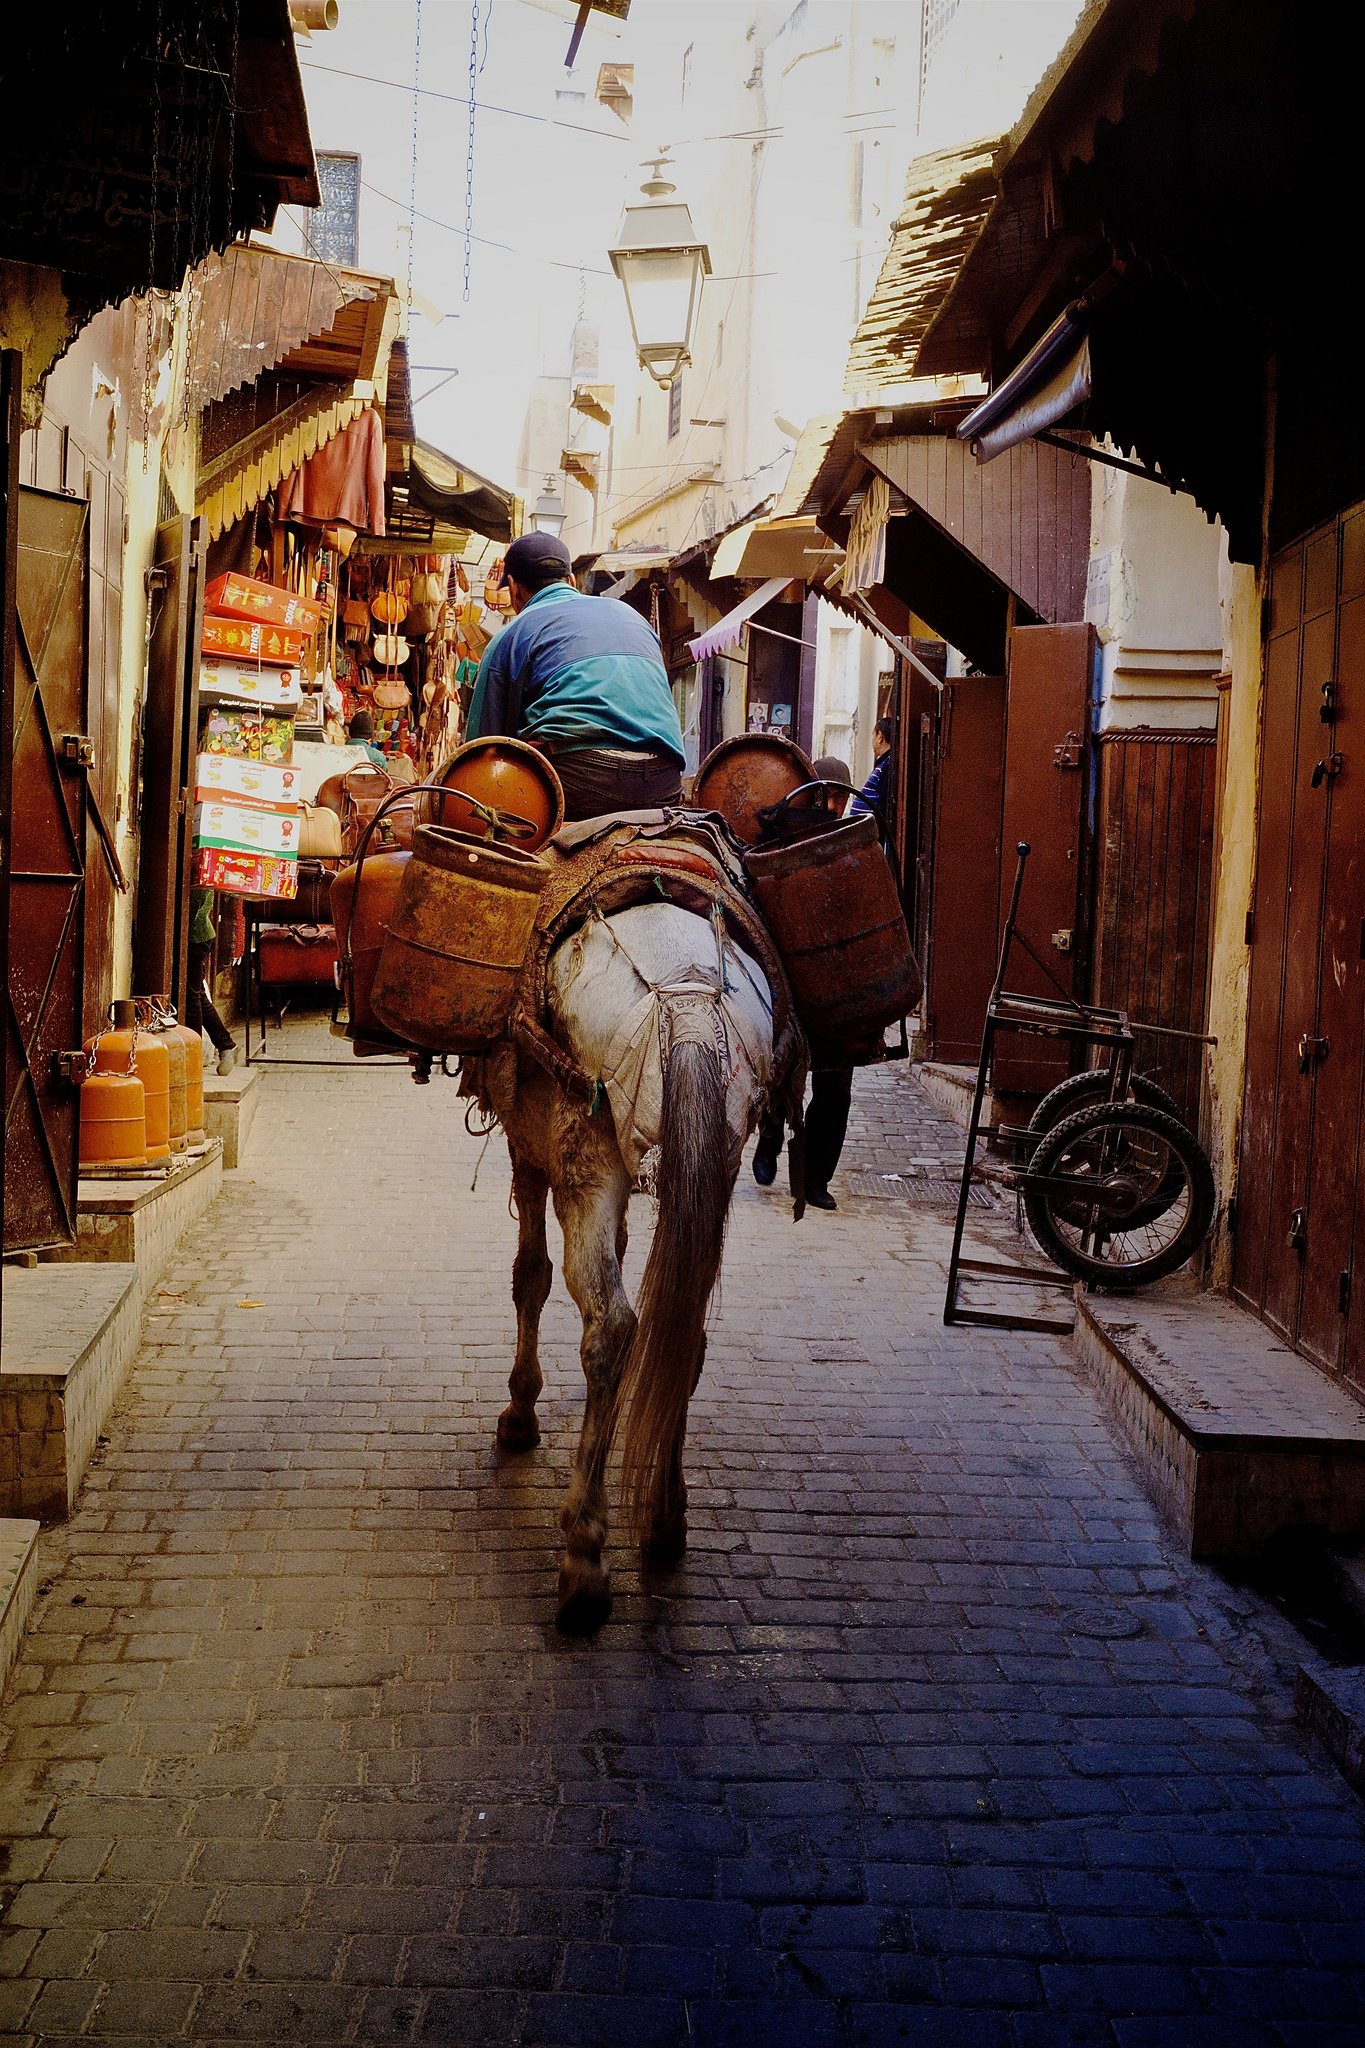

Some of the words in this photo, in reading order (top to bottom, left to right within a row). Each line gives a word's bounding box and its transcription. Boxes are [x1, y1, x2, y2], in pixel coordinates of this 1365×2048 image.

[115, 122, 144, 155] AL
[284, 598, 298, 625] TRIOS
[250, 624, 260, 654] TRIOS
